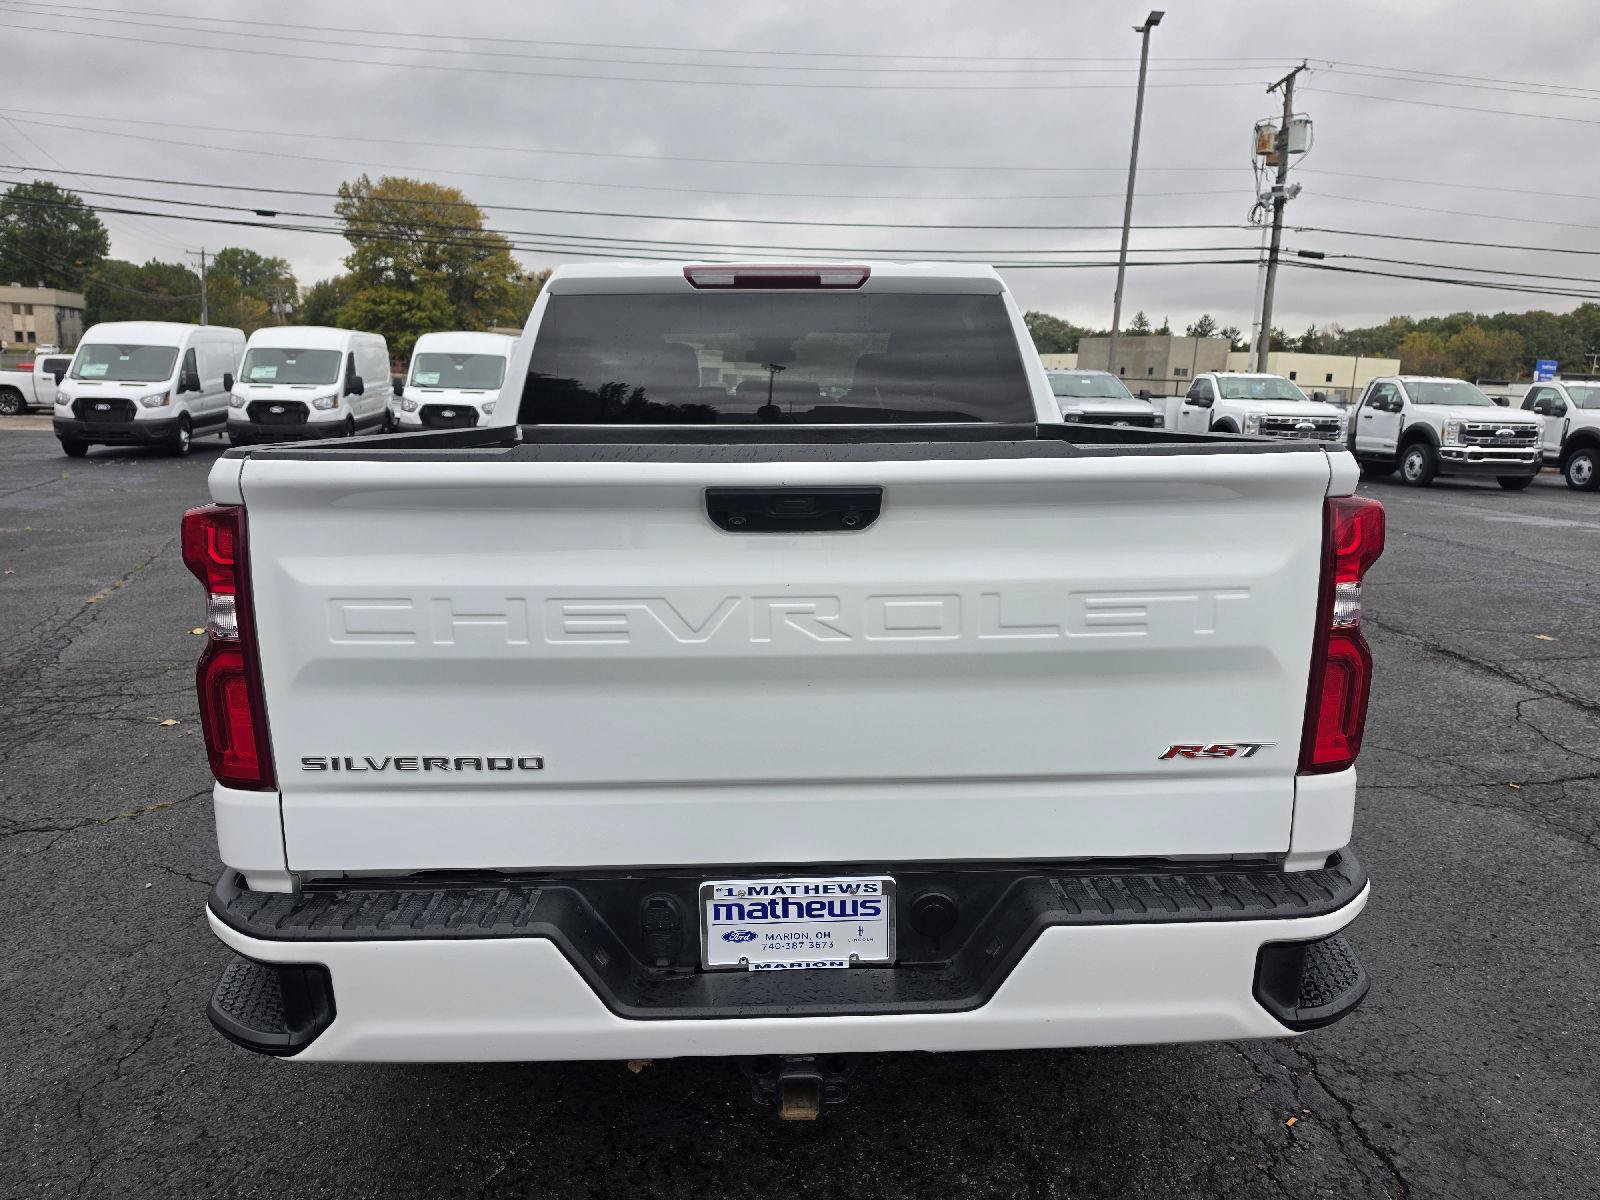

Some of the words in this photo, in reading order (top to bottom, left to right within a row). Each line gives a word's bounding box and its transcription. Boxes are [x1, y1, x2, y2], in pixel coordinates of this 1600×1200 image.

[326, 585, 1251, 646] CHEVROLET
[1157, 742, 1276, 760] RST
[300, 756, 544, 771] SILVERADO
[747, 883, 878, 896] MATHEWS
[713, 897, 882, 921] mathews
[765, 931, 812, 941] MARION,
[815, 931, 831, 940] OH
[754, 961, 844, 970] MARION
